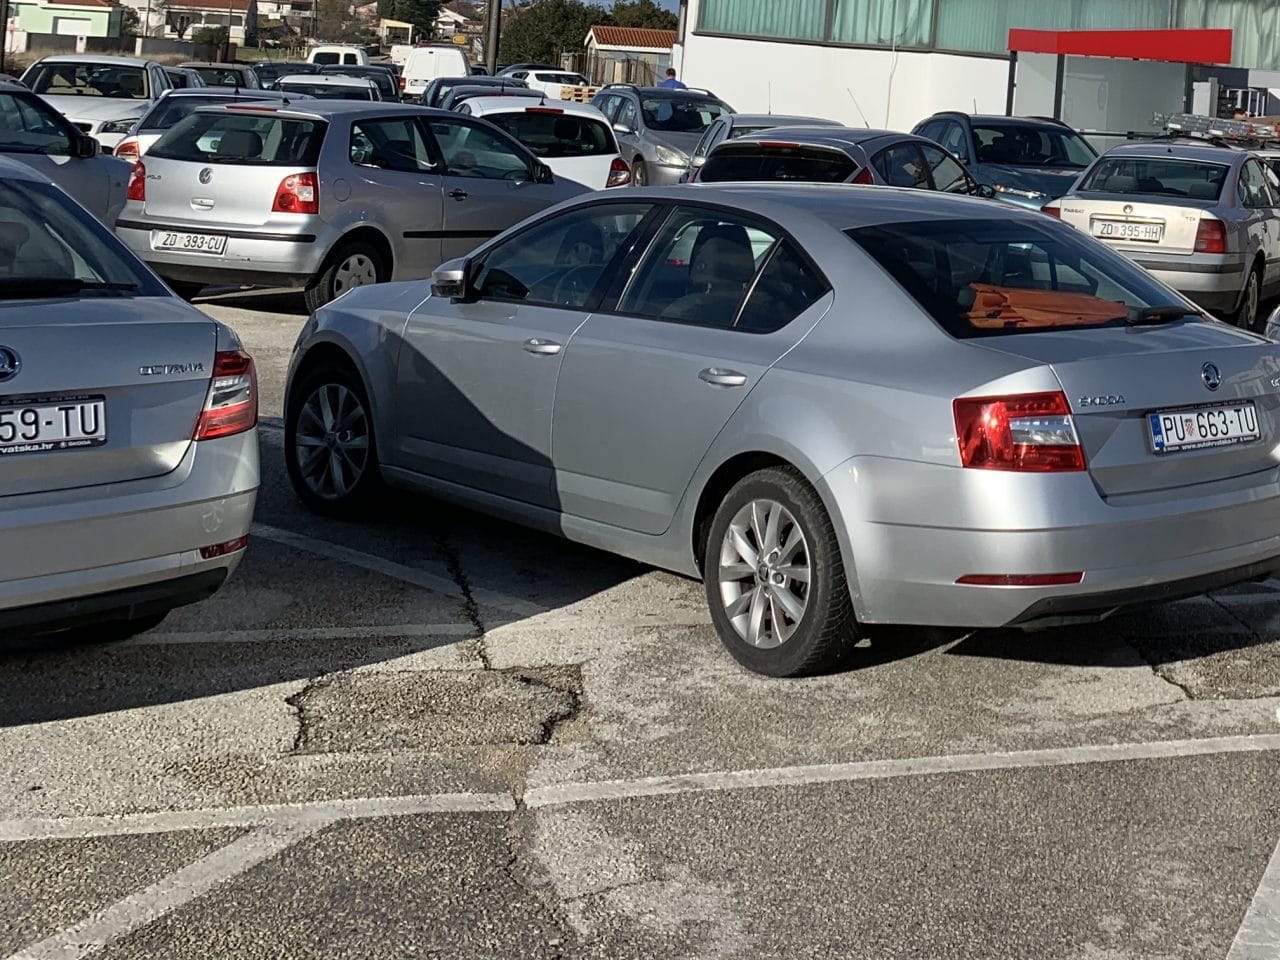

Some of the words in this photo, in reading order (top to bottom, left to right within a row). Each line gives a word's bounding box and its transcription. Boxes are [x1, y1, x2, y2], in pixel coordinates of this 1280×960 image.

[1100, 223, 1113, 235] ZD
[1120, 224, 1158, 239] 395-HH
[163, 233, 177, 246] ZD
[1163, 416, 1185, 442] PU
